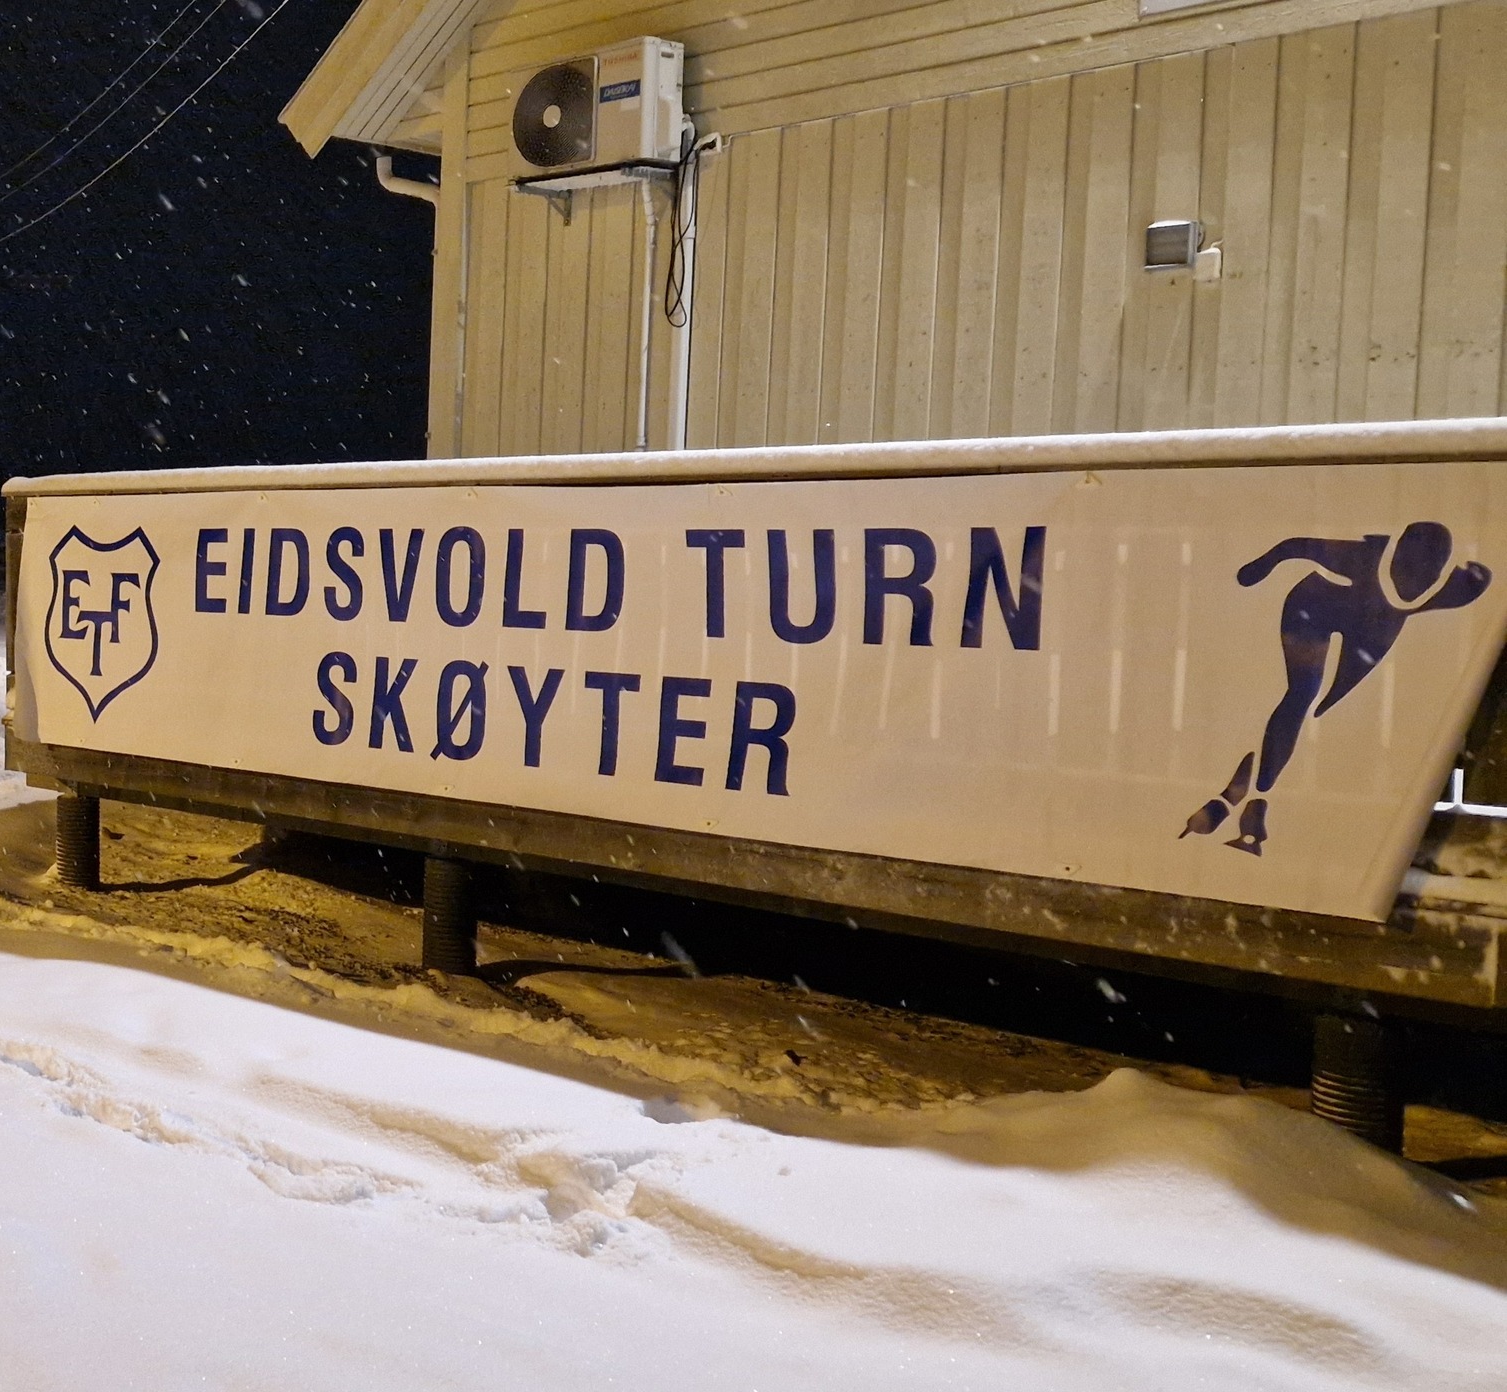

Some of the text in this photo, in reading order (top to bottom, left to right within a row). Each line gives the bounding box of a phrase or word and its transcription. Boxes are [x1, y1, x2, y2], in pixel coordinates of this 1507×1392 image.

[195, 526, 1047, 650] EIDSVOLD TURN
[312, 651, 797, 797] SKØYTER
